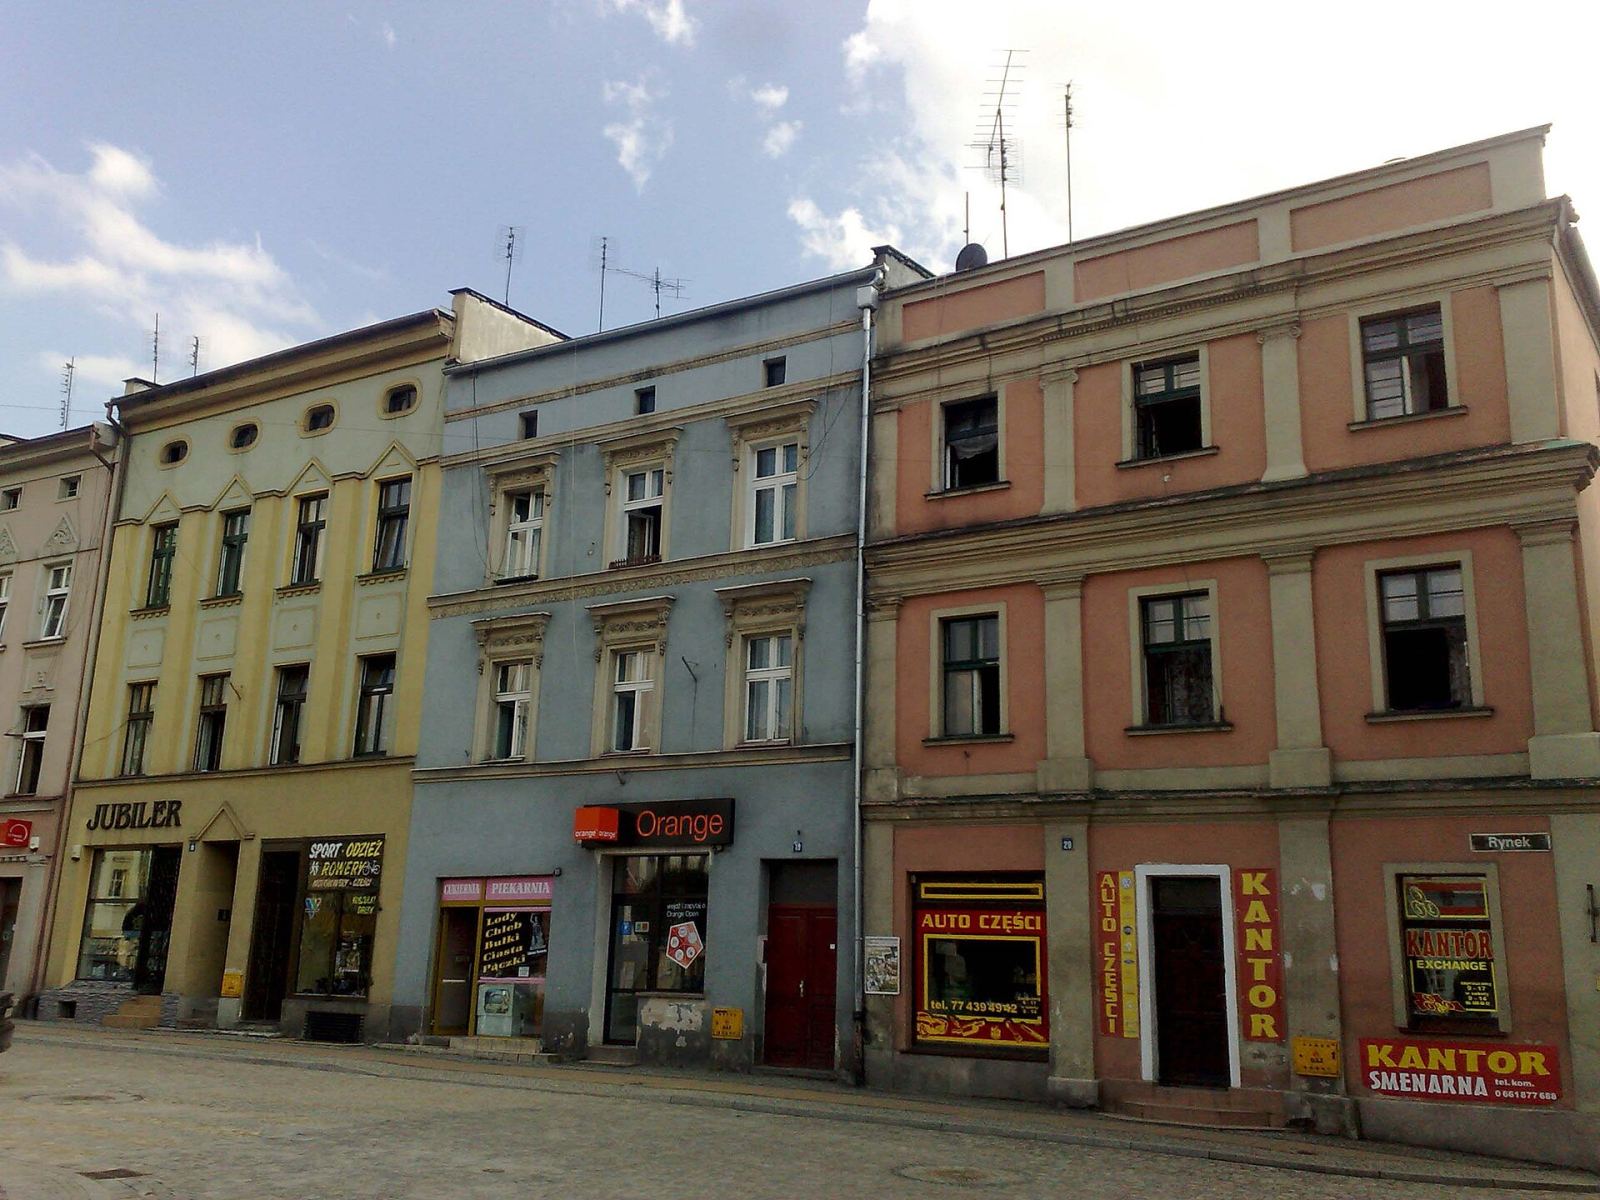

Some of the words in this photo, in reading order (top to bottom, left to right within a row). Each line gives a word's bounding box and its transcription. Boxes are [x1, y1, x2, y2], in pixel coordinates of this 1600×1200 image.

[86, 800, 183, 831] JUBILER
[636, 810, 724, 842] Orange
[575, 831, 596, 839] orange
[1488, 836, 1531, 850] Rynek
[309, 843, 343, 858] SPORT
[320, 861, 366, 876] ROWERY
[491, 882, 550, 895] PIEKARNIA
[1100, 874, 1117, 932] AUTO
[486, 912, 517, 926] Lody
[921, 913, 971, 929] AUTO
[979, 911, 1041, 933] CZĘŚCI
[485, 921, 522, 938] Chleb
[1407, 930, 1494, 959] KANTOR
[482, 945, 524, 962] Ciasta
[1241, 872, 1279, 1038] KANTOR
[1416, 959, 1488, 971] EXCHANGE
[930, 1000, 948, 1010] tel.
[951, 1000, 965, 1010] 77
[1367, 1044, 1550, 1076] KANTOR
[1369, 1070, 1488, 1096] SMENARNA
[1494, 1078, 1511, 1086] tel.
[1511, 1079, 1535, 1087] kom.
